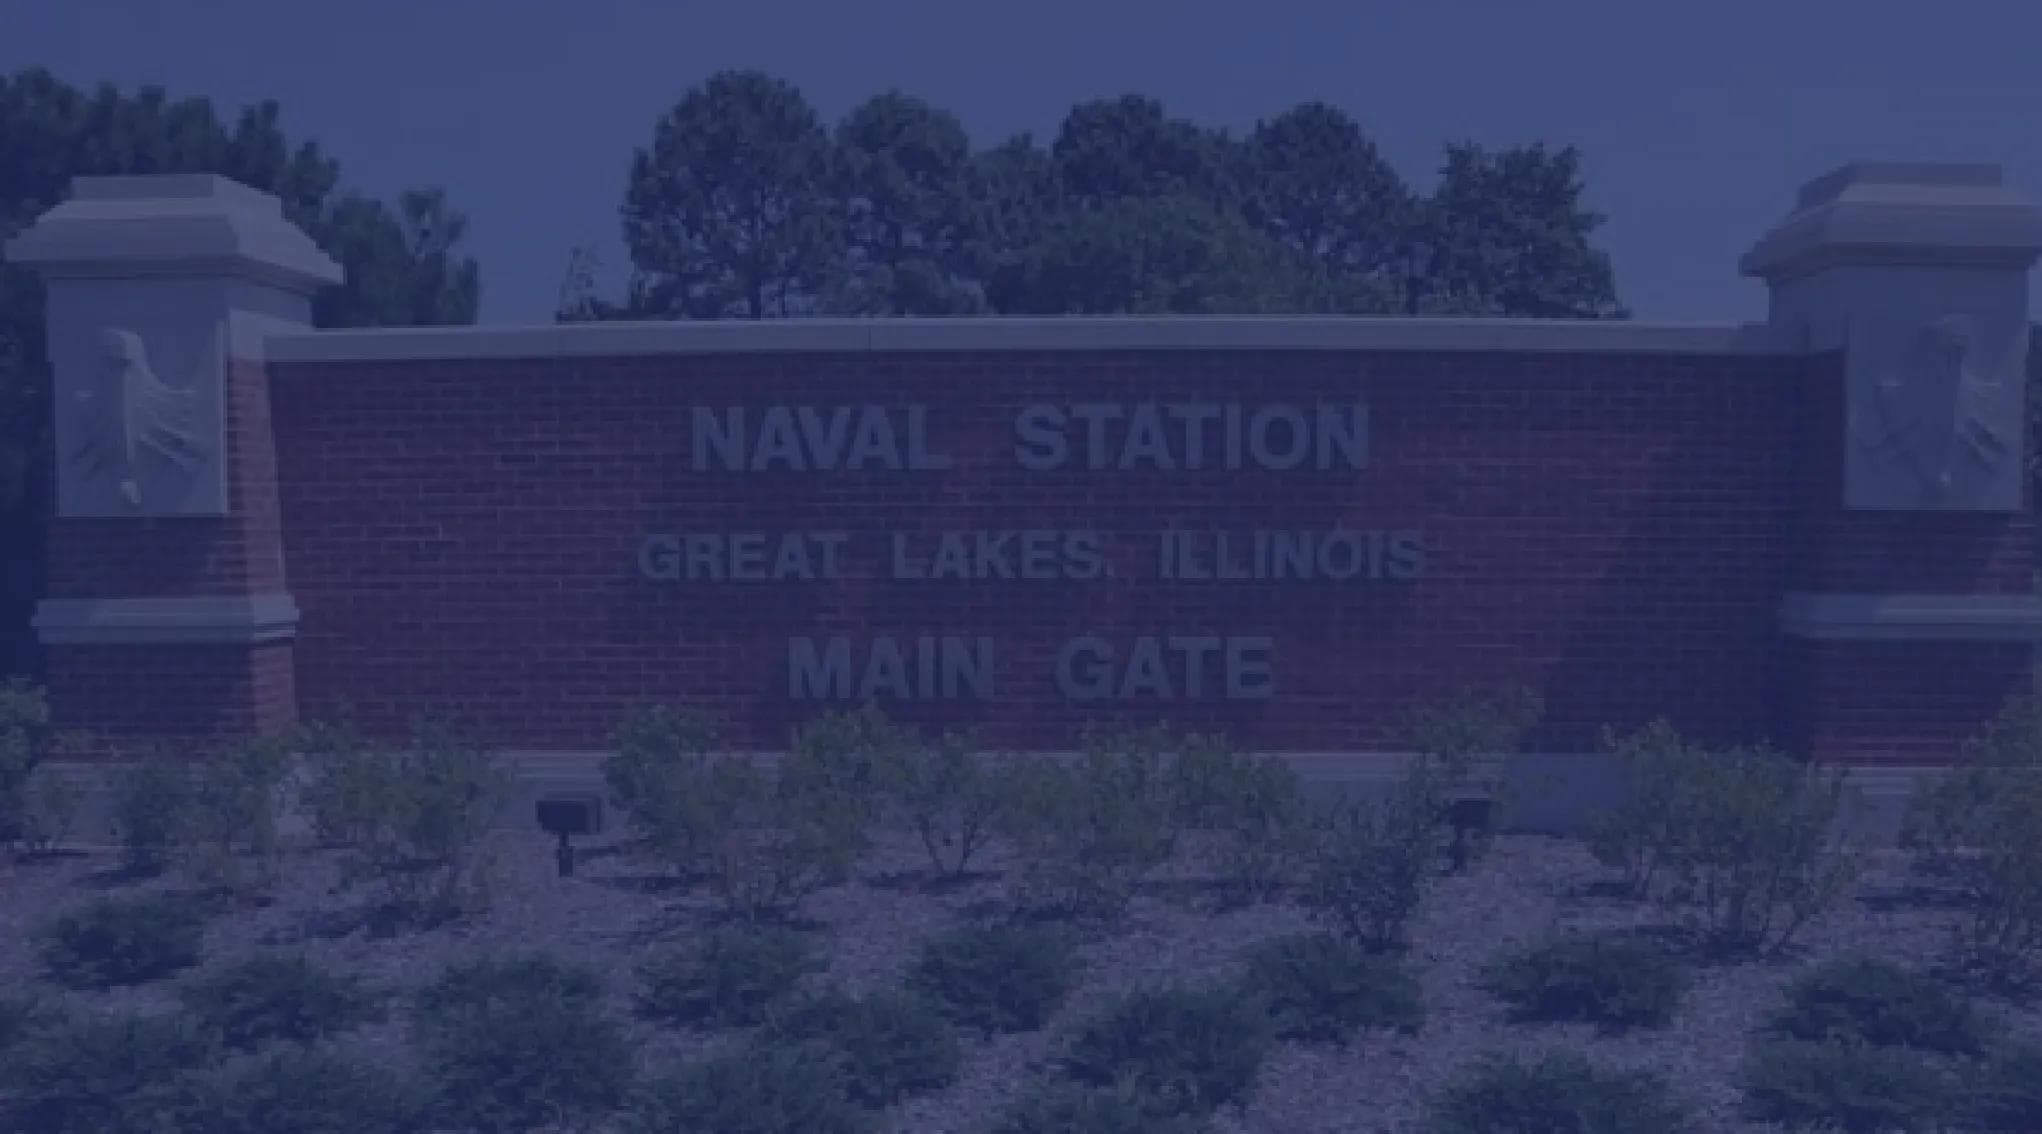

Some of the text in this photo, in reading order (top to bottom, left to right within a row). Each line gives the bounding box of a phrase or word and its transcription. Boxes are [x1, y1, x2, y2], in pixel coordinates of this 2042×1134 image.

[690, 403, 1370, 471] NAVAL STATION
[637, 532, 848, 580] GREAT
[1160, 529, 1427, 580] ILLINOIS
[788, 635, 1275, 699] MAIN GATE
